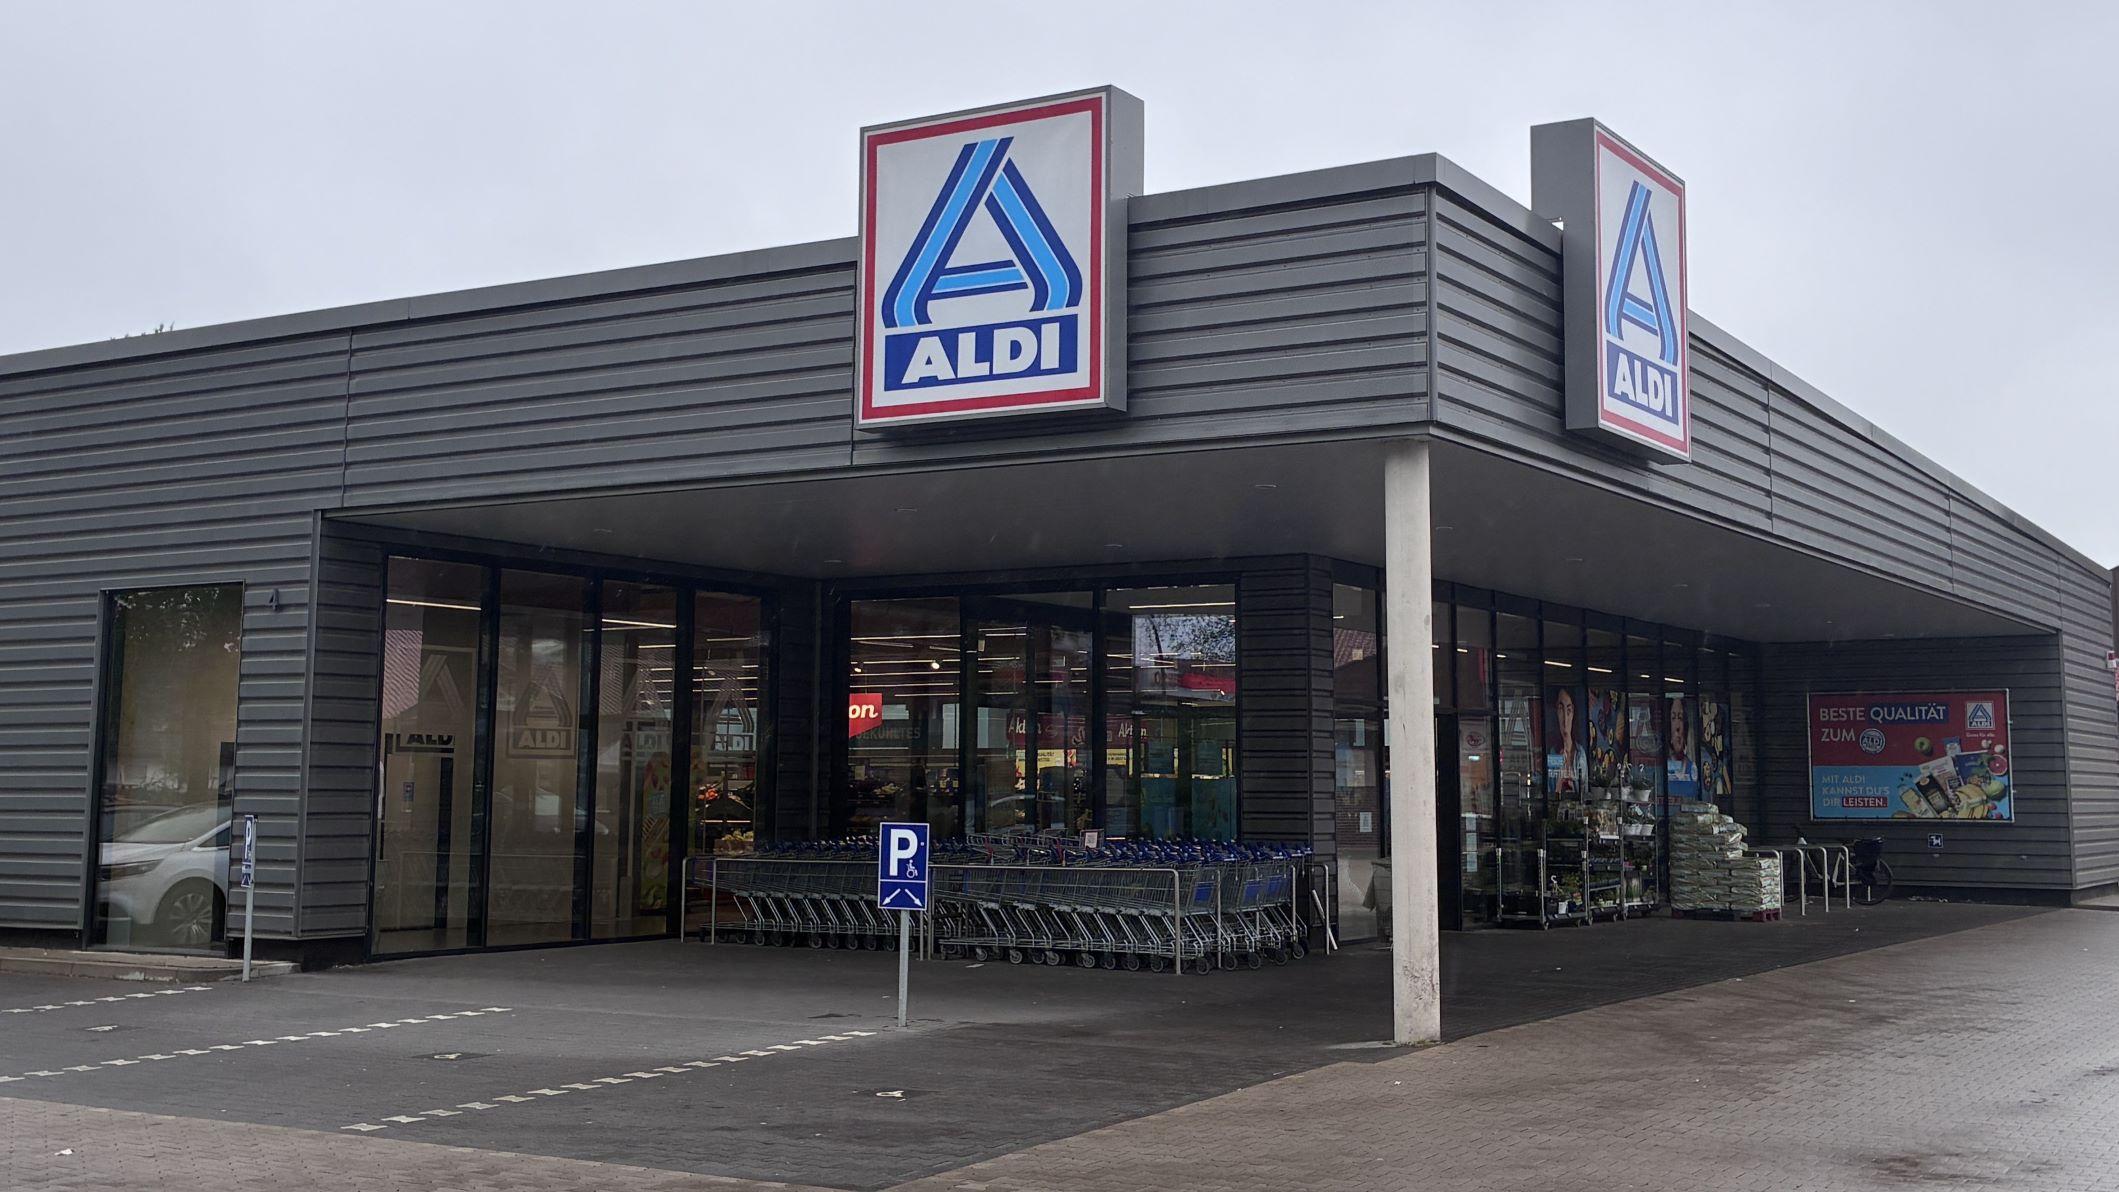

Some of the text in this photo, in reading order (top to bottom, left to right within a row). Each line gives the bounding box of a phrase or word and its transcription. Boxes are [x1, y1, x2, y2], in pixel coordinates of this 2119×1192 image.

[901, 322, 1060, 384] ALDI
[1614, 352, 1673, 418] ALDI
[1820, 703, 1946, 723] BESTE QUALITÄT
[518, 730, 566, 749] ALDI
[1821, 728, 1856, 742] ZUM
[1822, 775, 1865, 783] MIT ALDI
[1822, 786, 1866, 795] KANNST
[1823, 798, 1887, 807] DIR LEISTEN.
[245, 820, 252, 860] P
[889, 828, 918, 876] P
